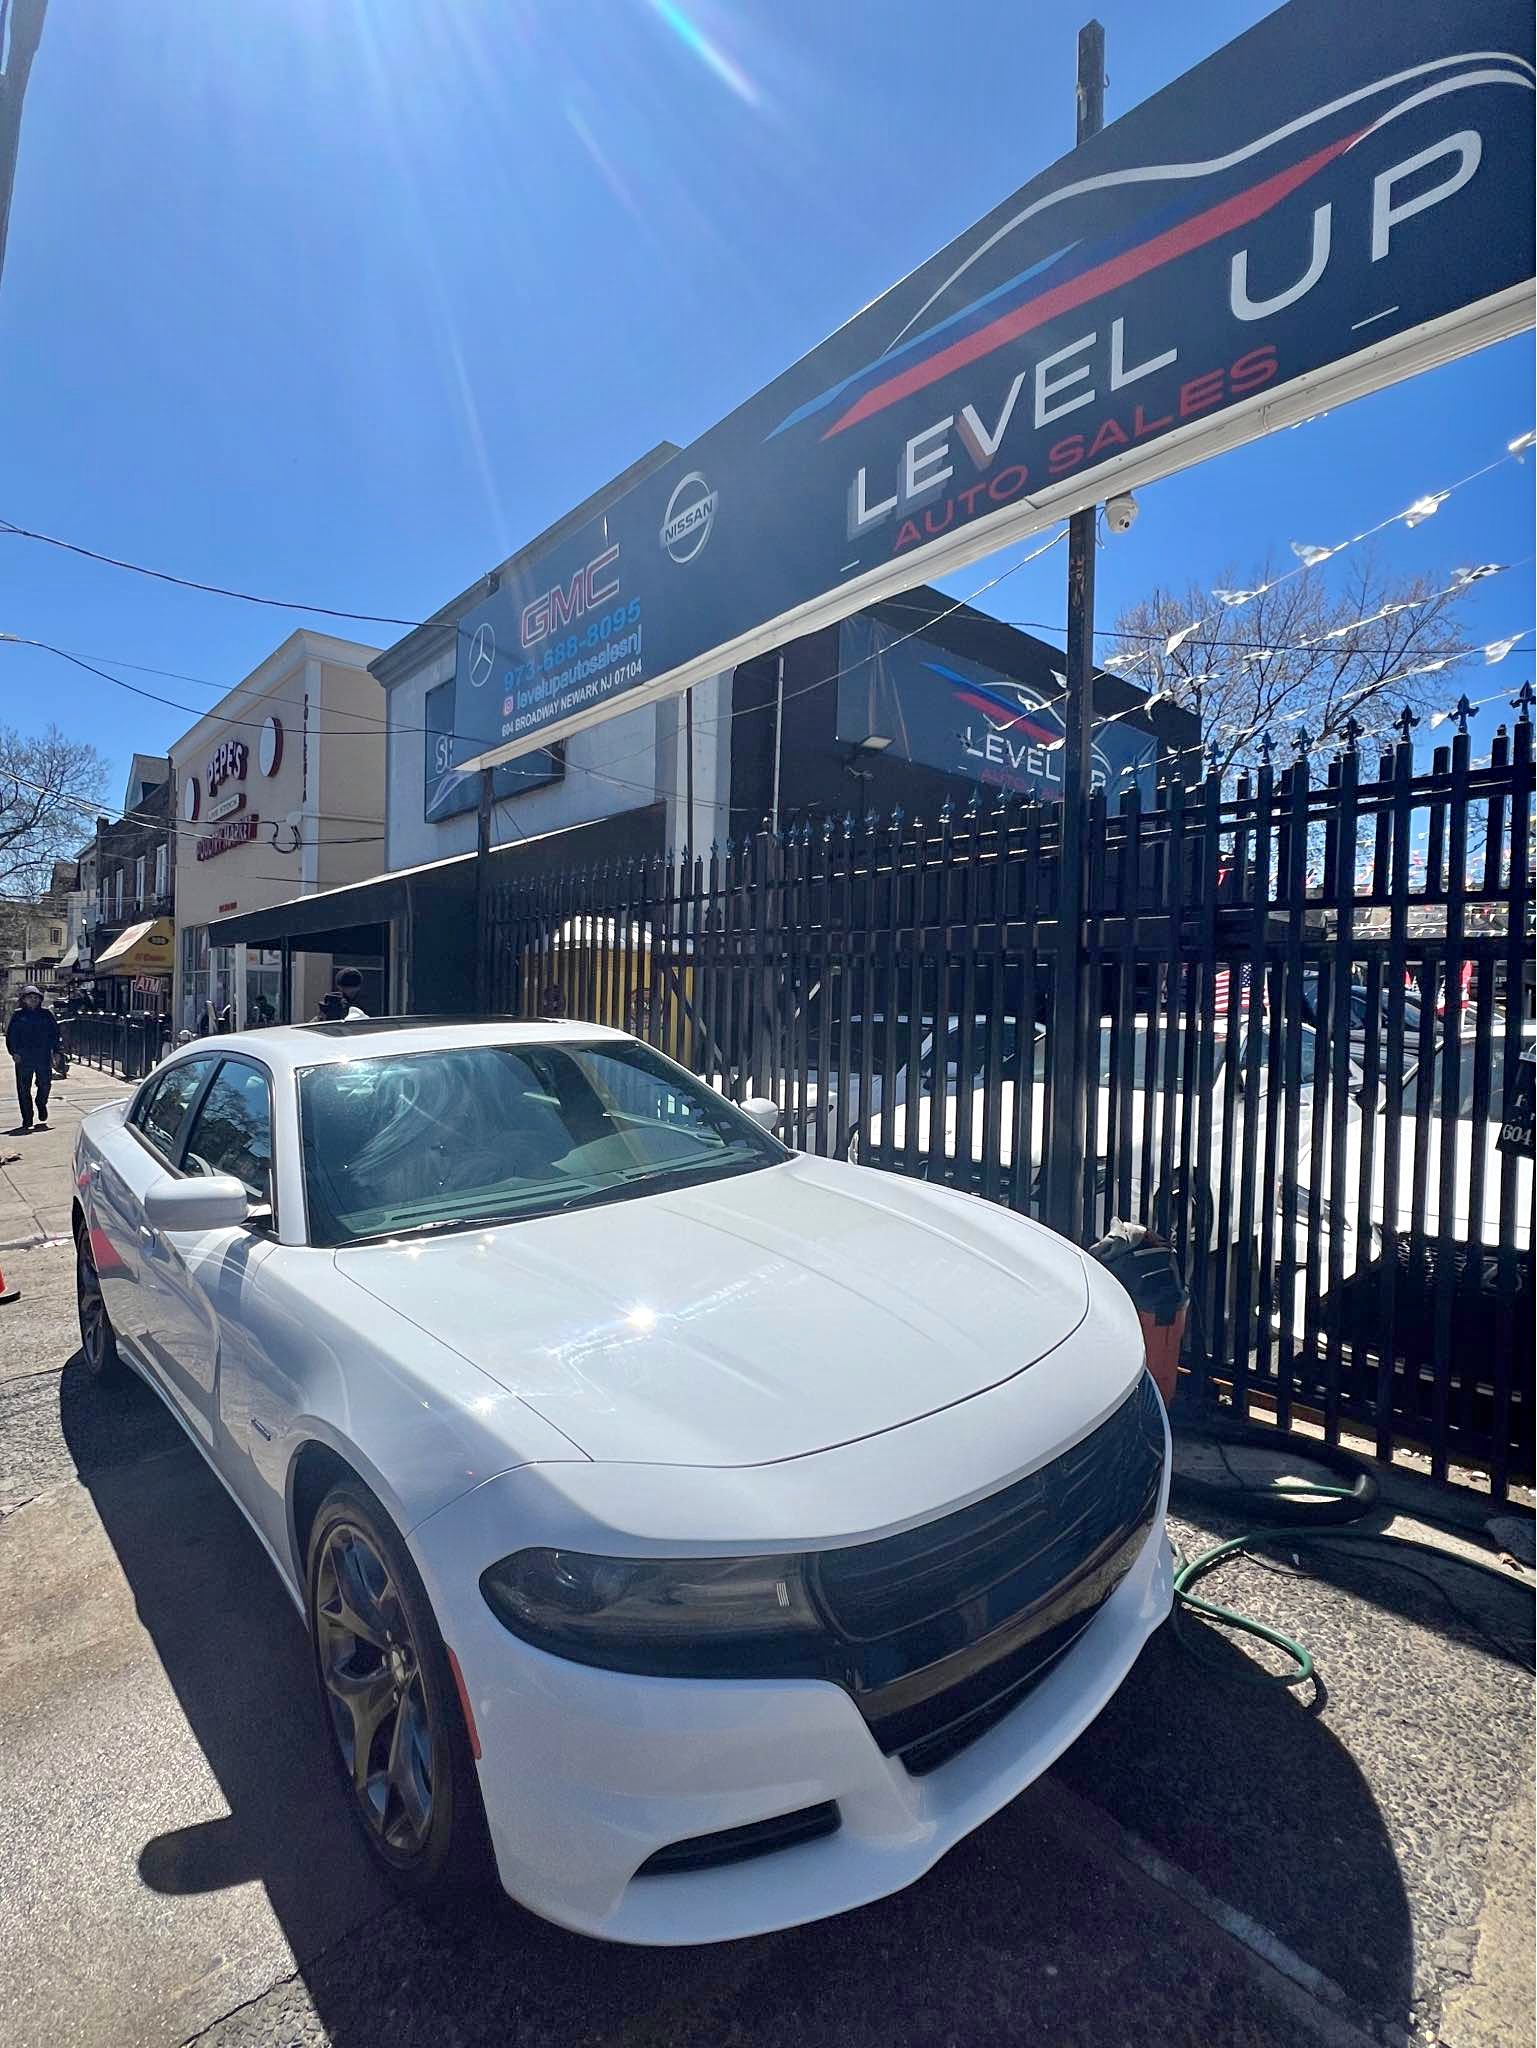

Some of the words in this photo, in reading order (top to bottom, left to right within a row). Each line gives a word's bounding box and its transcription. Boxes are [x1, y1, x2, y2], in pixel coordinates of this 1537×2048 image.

[856, 318, 1178, 527] LEVEL
[1230, 129, 1483, 322] UP
[893, 464, 1030, 553] AUTO
[1048, 345, 1279, 476] SALES
[665, 499, 713, 542] NISSAN
[521, 543, 620, 650] GMC
[504, 598, 641, 691] 973-688-8095
[501, 720, 514, 738] 604
[515, 701, 561, 732] BROADWAY
[560, 680, 599, 711] NEWARK
[600, 676, 613, 692] NJ
[614, 658, 643, 685] 07104
[208, 741, 248, 797] PEPE'S
[967, 726, 1061, 782] LEVEL
[136, 976, 160, 994] ATM
[1502, 1124, 1533, 1147] 604
